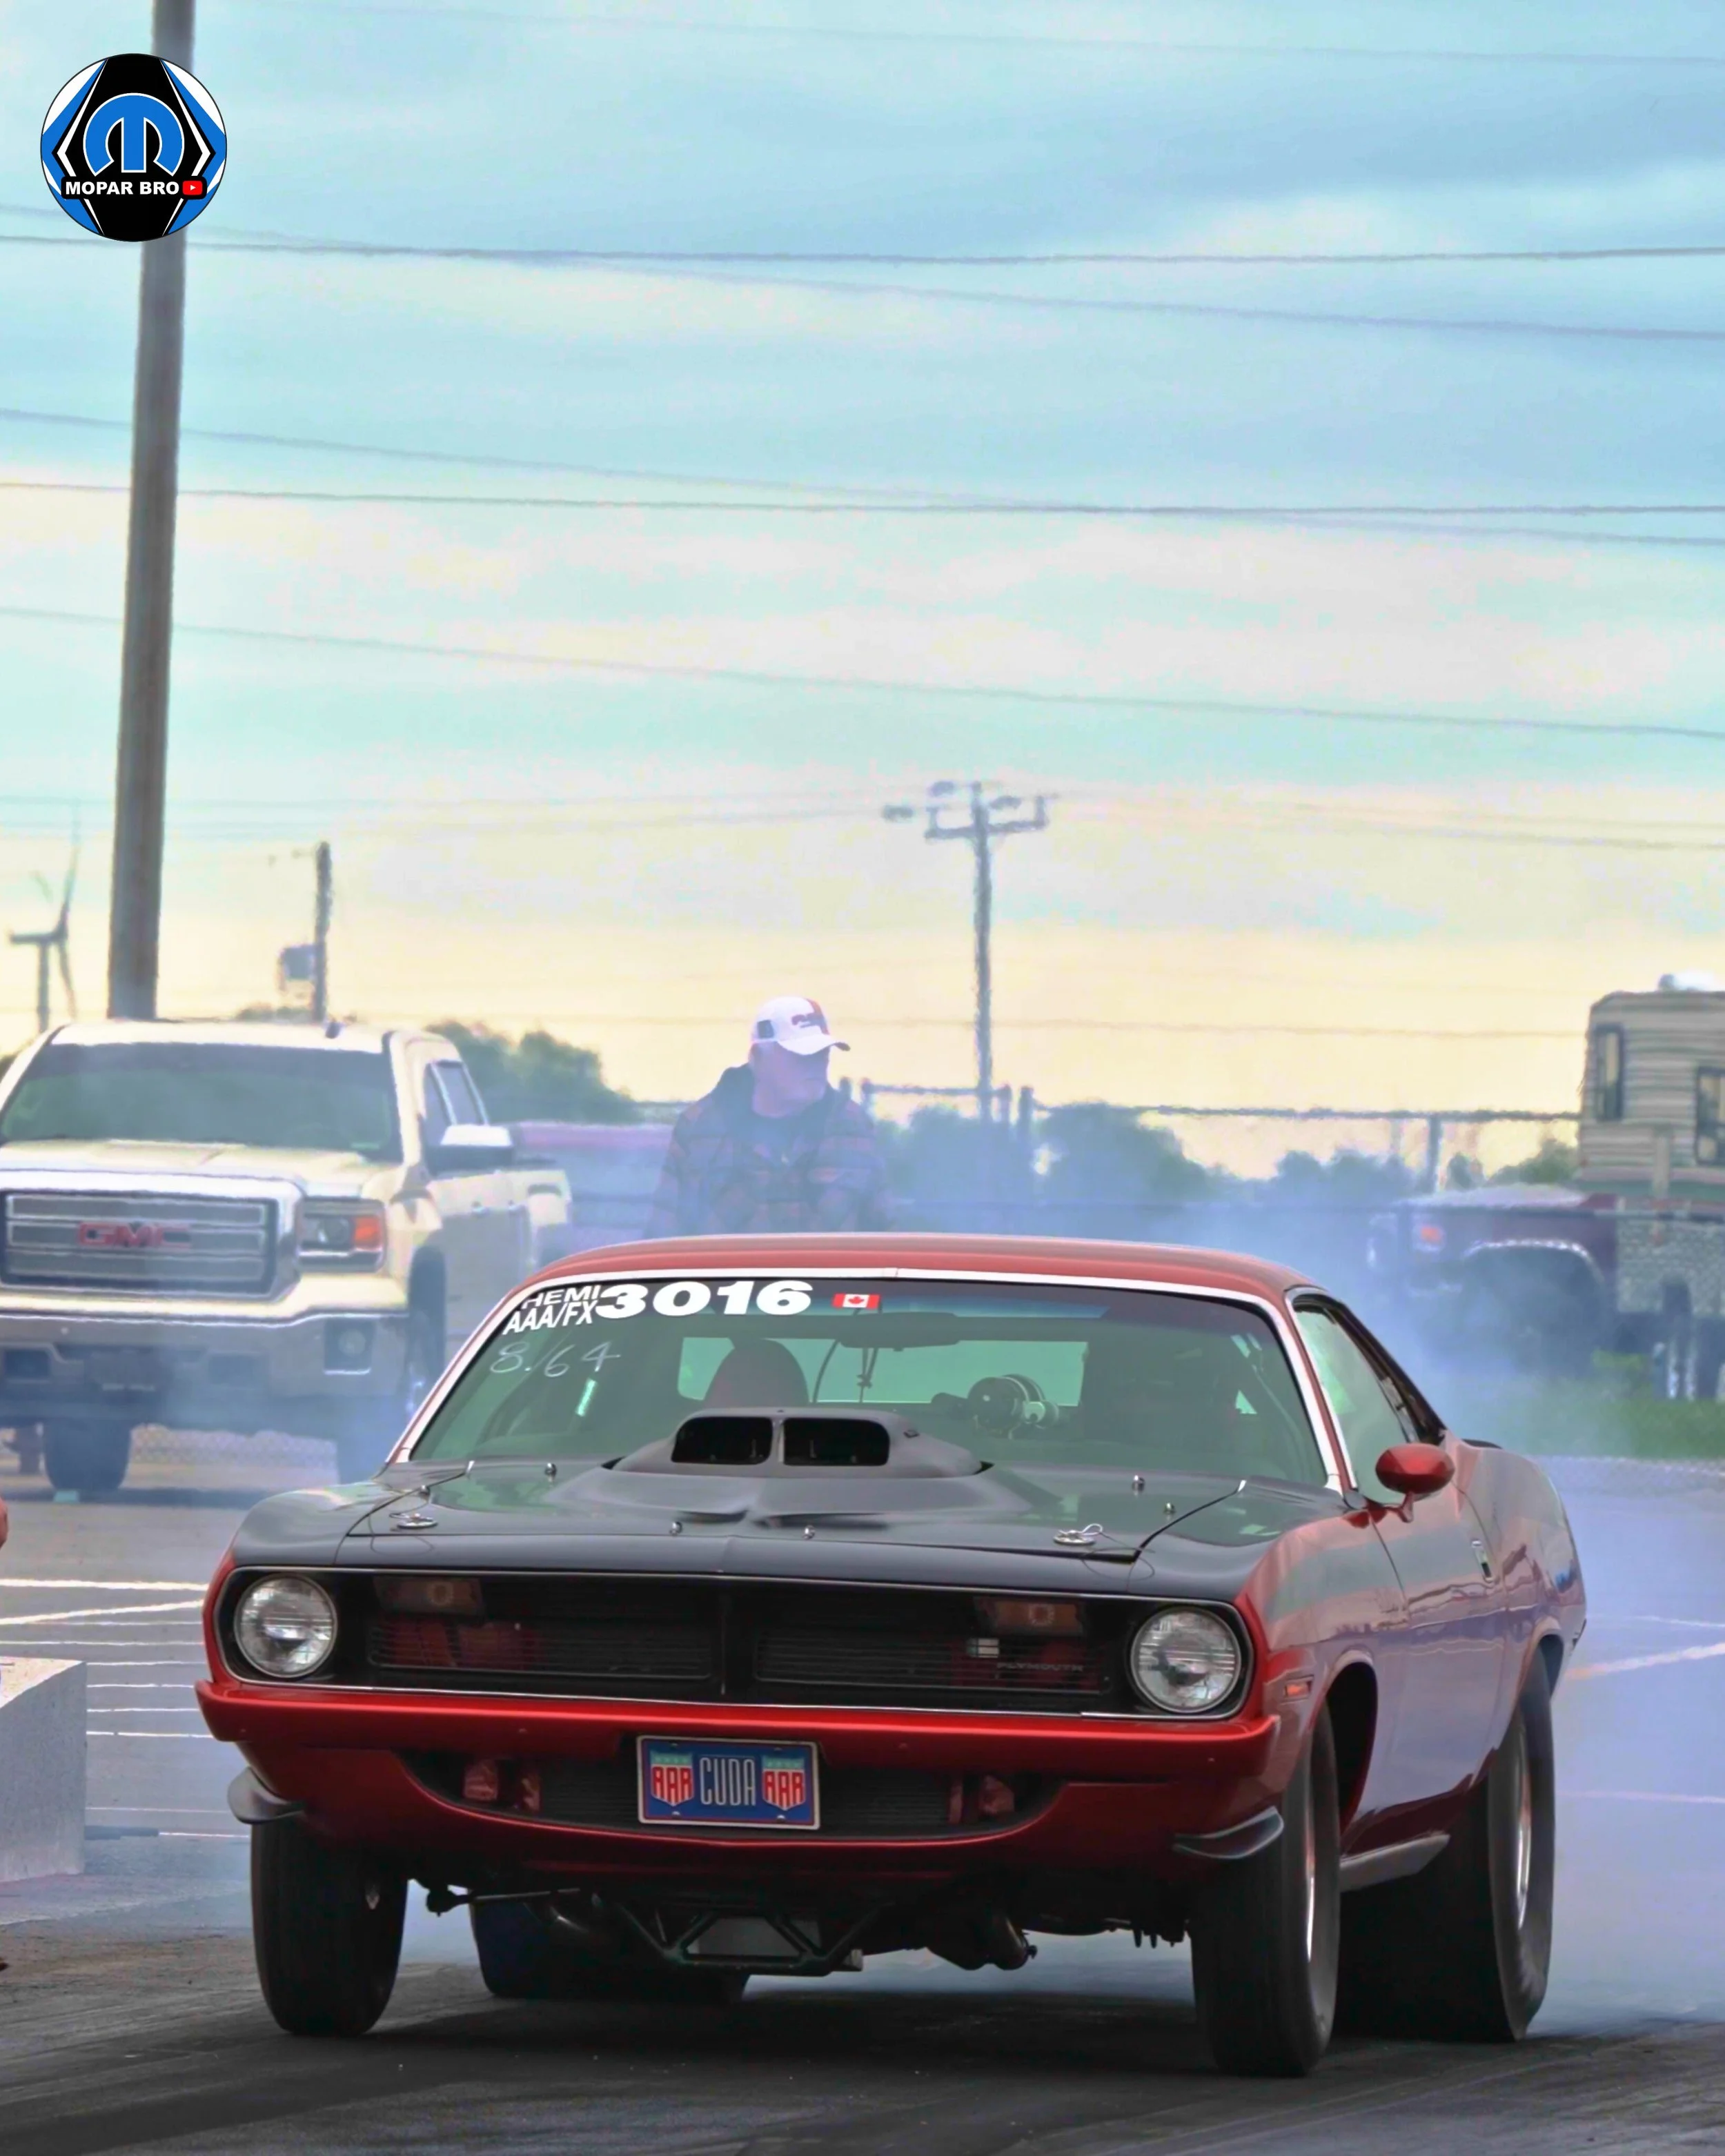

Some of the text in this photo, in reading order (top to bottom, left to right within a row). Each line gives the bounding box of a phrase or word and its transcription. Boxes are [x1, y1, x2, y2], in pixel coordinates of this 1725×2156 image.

[77, 1221, 191, 1250] GMC
[521, 1285, 602, 1309] HEMI
[595, 1280, 813, 1318] 3016
[502, 1300, 598, 1335] AAA/FX
[490, 1341, 620, 1377] 8.64
[700, 1757, 756, 1806] CUDA
